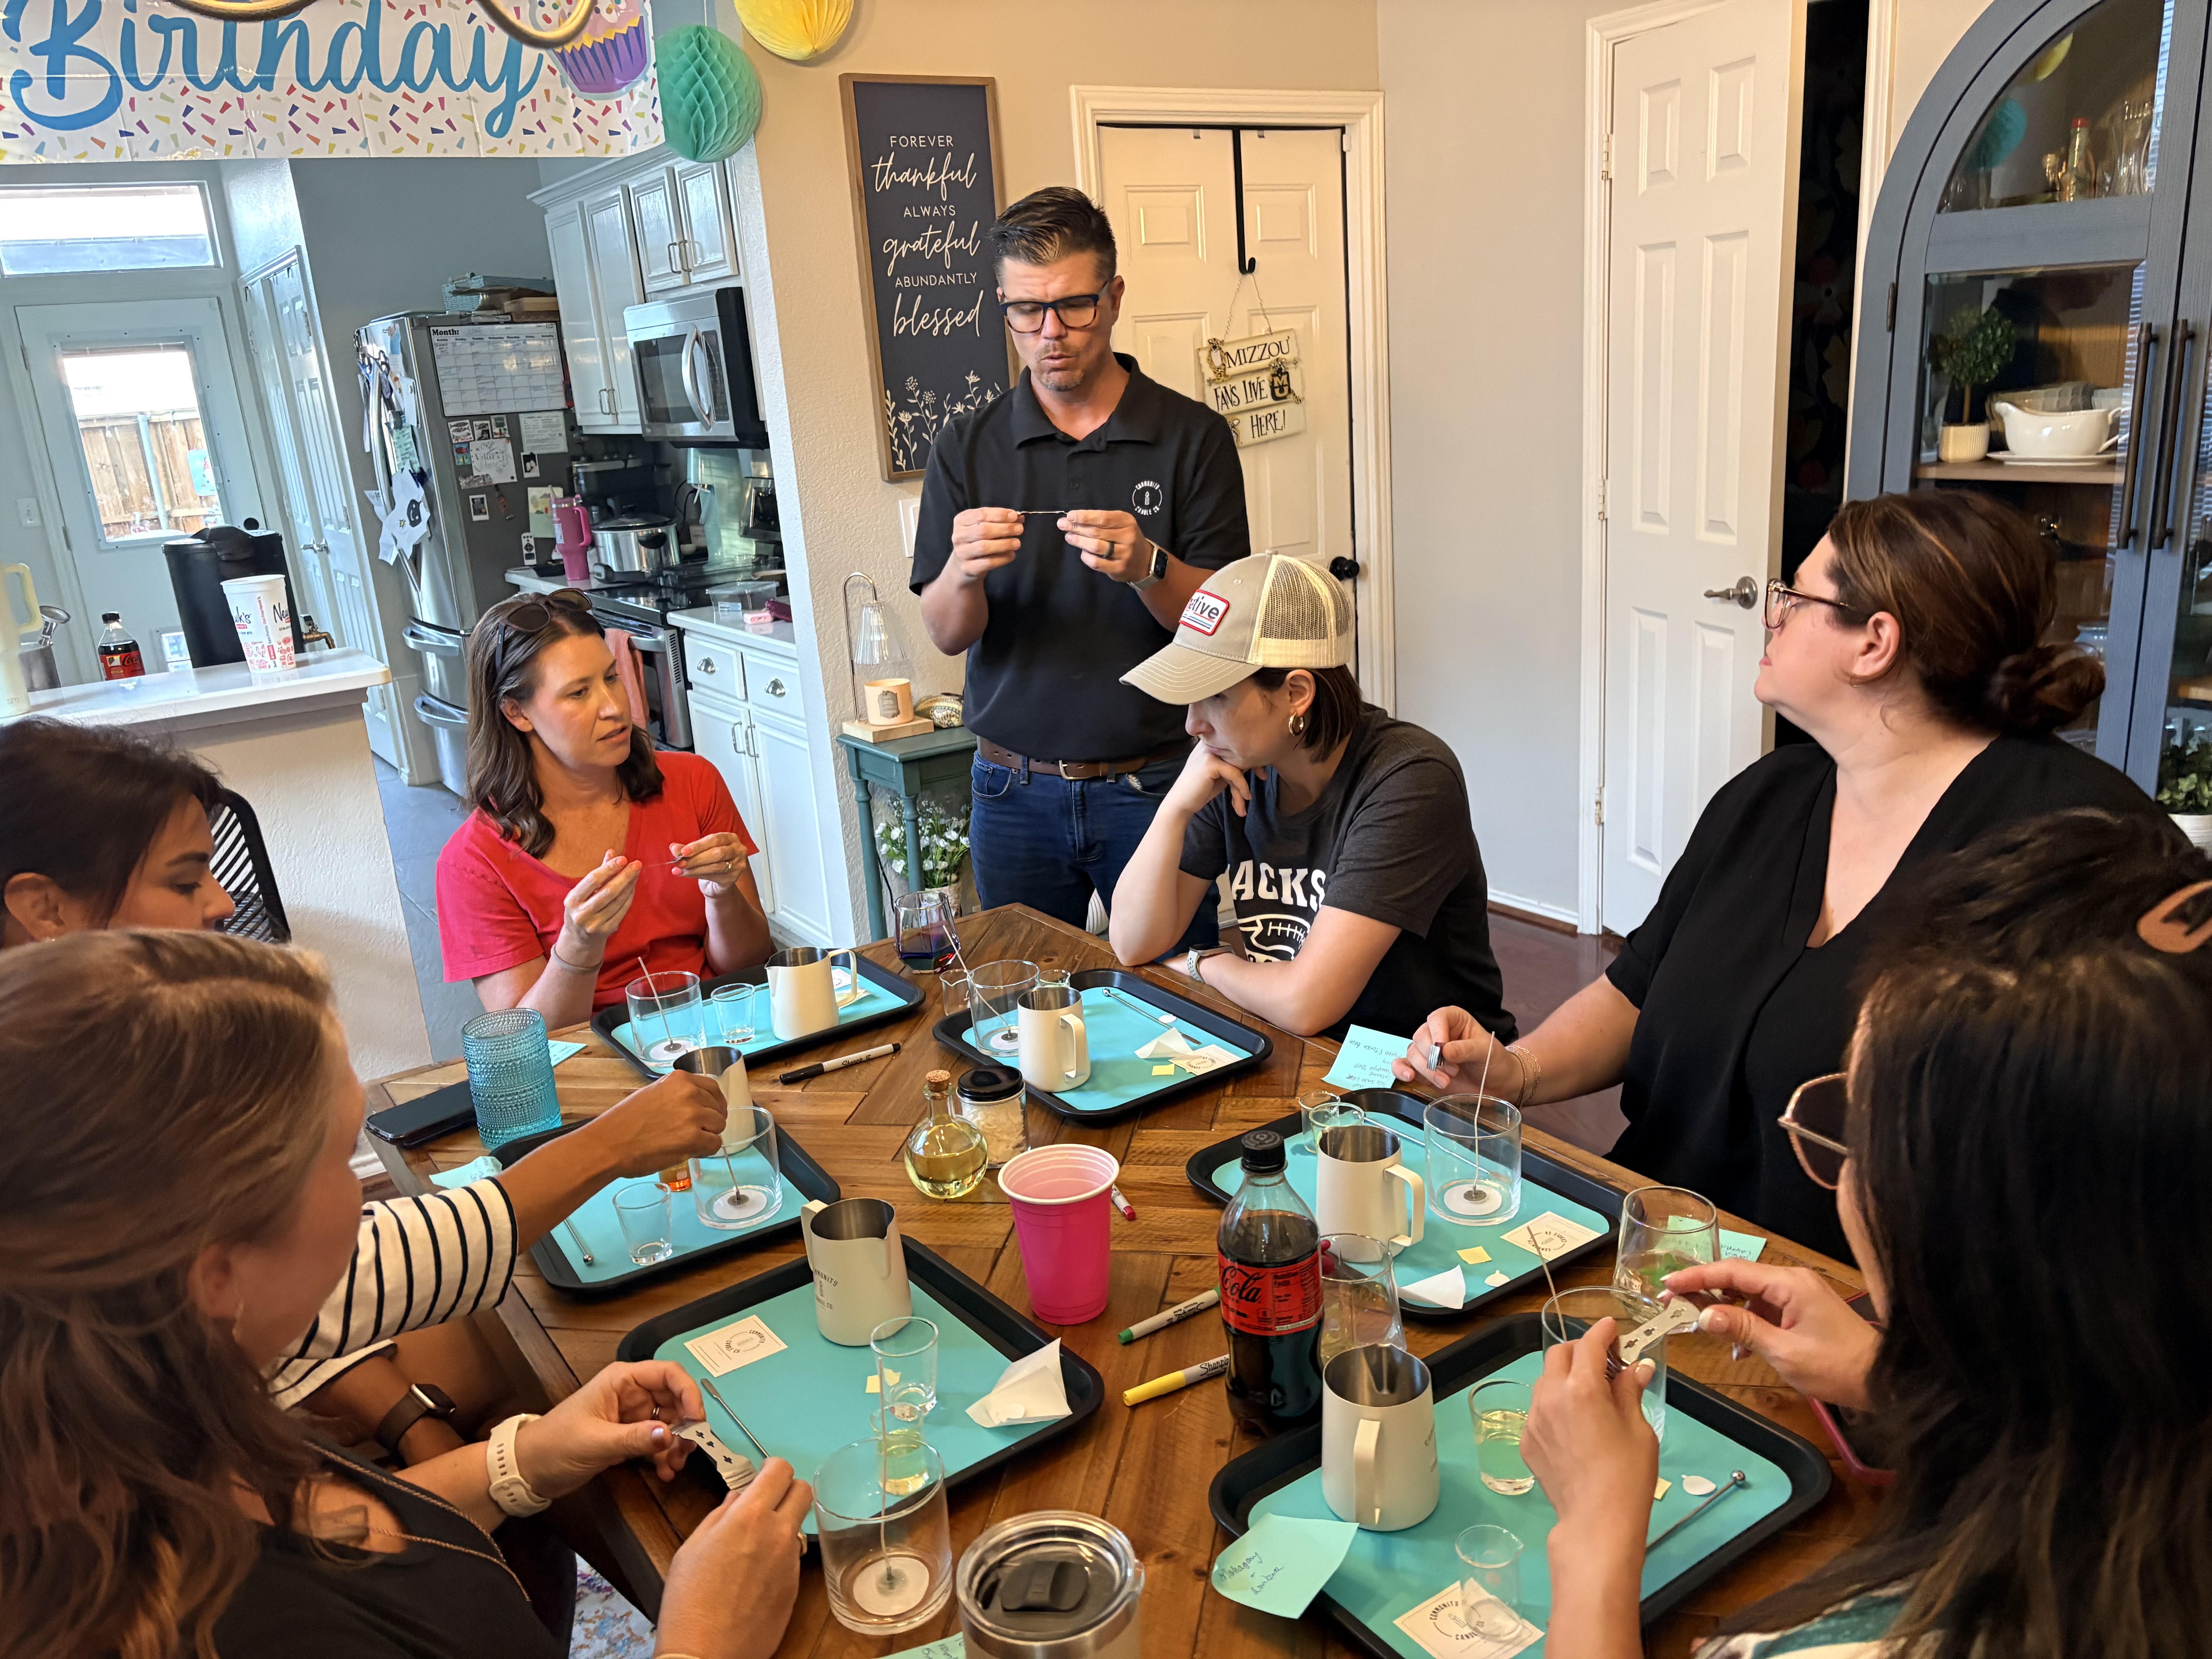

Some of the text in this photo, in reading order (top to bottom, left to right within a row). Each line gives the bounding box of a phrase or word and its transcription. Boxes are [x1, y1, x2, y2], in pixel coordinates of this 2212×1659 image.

[890, 135, 954, 148] FOREVER
[871, 151, 978, 201] thankful
[904, 205, 956, 218] ALWAYS
[883, 220, 980, 276] grateful
[895, 271, 977, 288] ABUNDANTLY
[893, 290, 983, 337] blessed
[1226, 336, 1290, 368] MIZZOU
[1214, 377, 1268, 412] FANS LIVE
[1250, 410, 1286, 438] HERE!
[1135, 481, 1160, 490] COMMUNITY
[1135, 506, 1152, 515] CANDLE
[1228, 860, 1326, 912] ACKS
[1222, 1266, 1268, 1303] Cola
[1430, 1601, 1459, 1621] COMMUNITY
